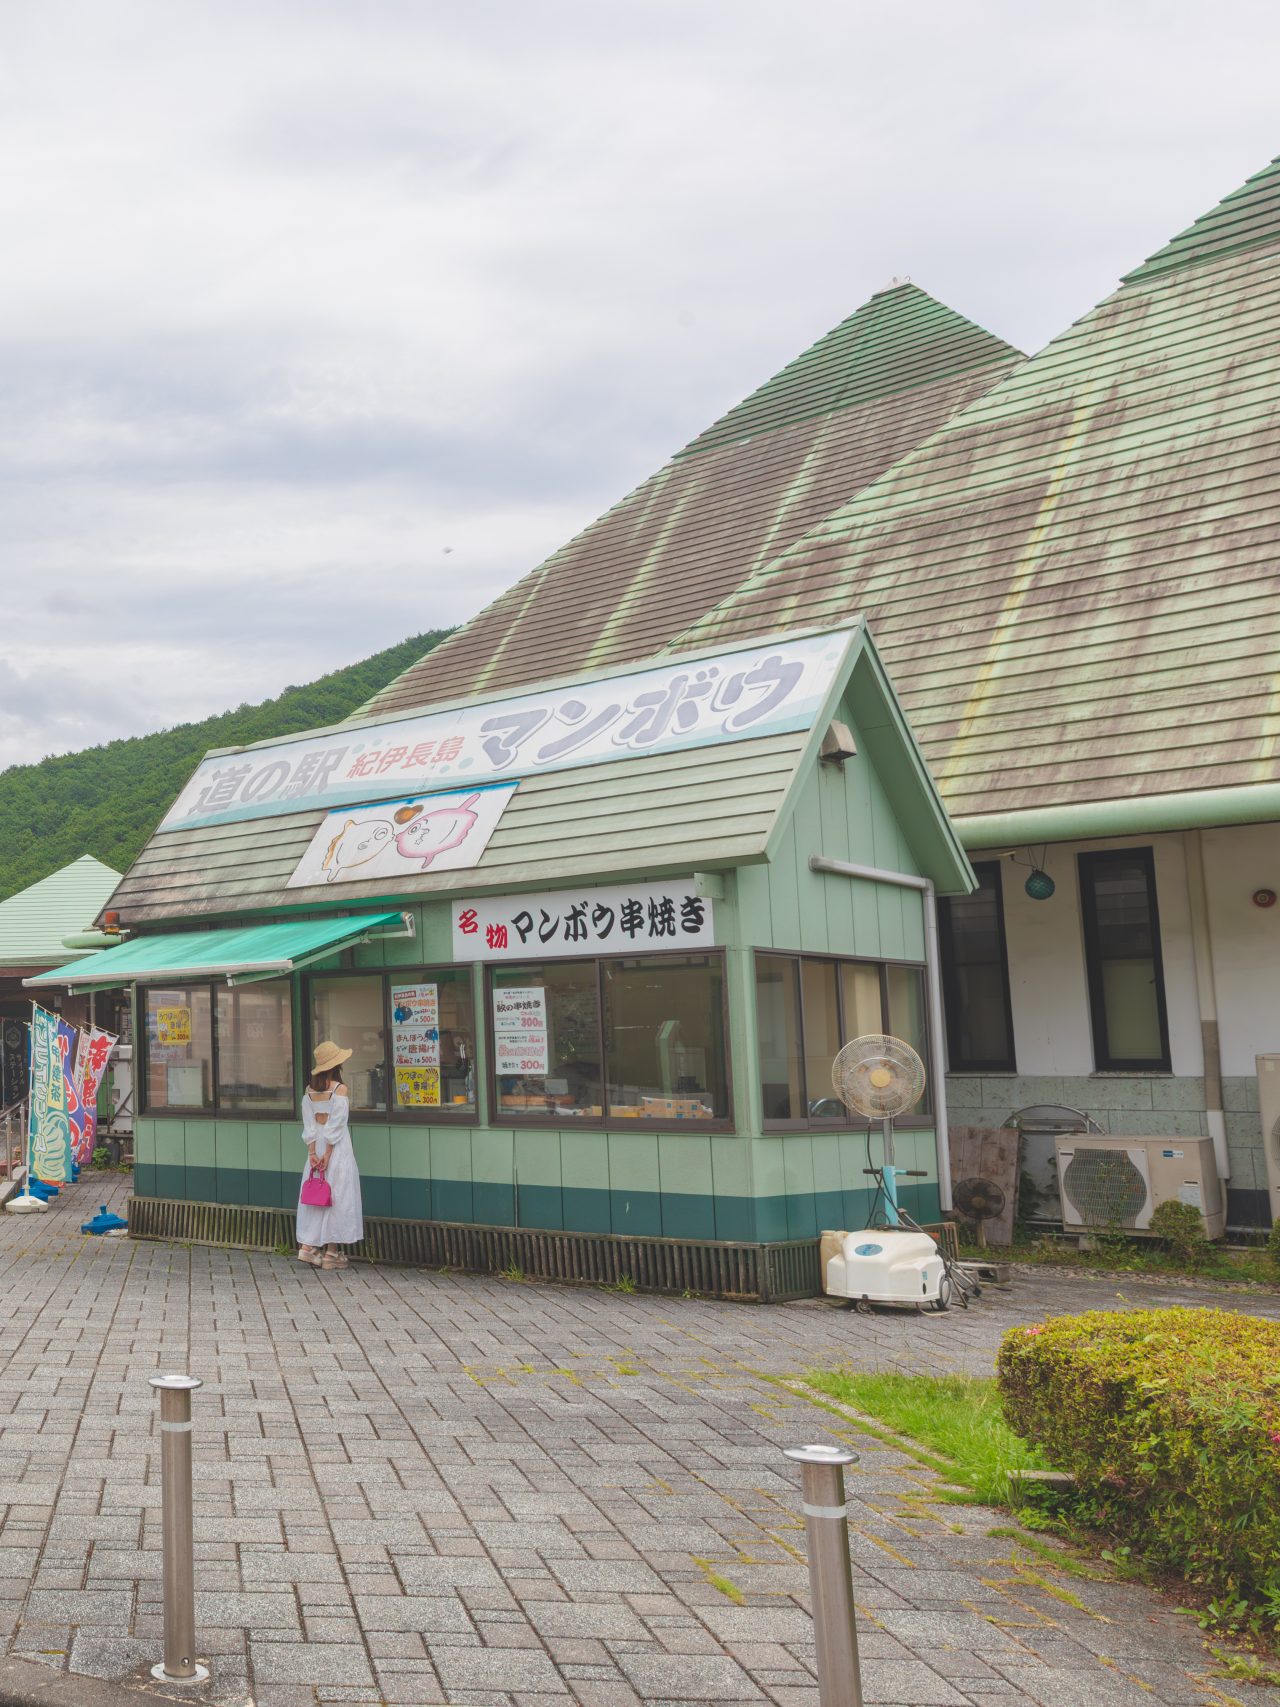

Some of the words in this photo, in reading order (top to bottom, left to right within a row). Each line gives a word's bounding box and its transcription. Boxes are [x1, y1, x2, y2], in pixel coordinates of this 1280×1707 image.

[187, 745, 350, 816] 道の駅
[346, 735, 466, 779] 紀伊長島
[479, 655, 805, 771] マンボウ
[458, 908, 509, 949] 名物
[511, 895, 706, 944] マンボウ串焼き
[521, 1017, 543, 1027] 300円
[520, 1061, 544, 1070] 300円
